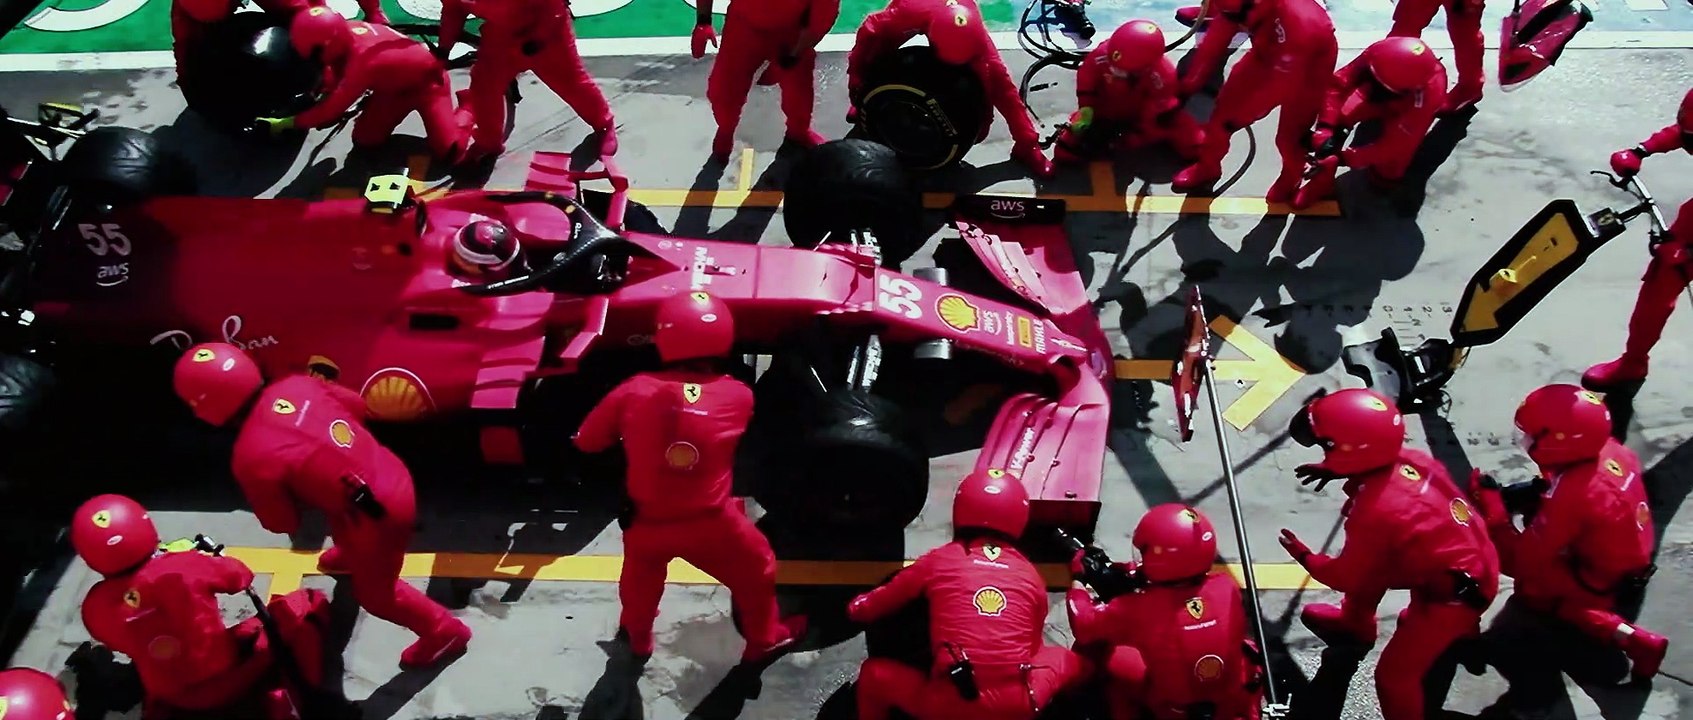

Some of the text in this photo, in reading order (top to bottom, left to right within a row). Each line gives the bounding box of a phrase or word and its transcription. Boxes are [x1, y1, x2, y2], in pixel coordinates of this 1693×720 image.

[990, 199, 1025, 212] aws
[78, 223, 131, 256] 55
[97, 262, 129, 279] aws
[878, 274, 923, 320] 55
[983, 310, 996, 334] aws
[1033, 319, 1046, 354] MAHLE
[1010, 427, 1035, 469] V-Power
